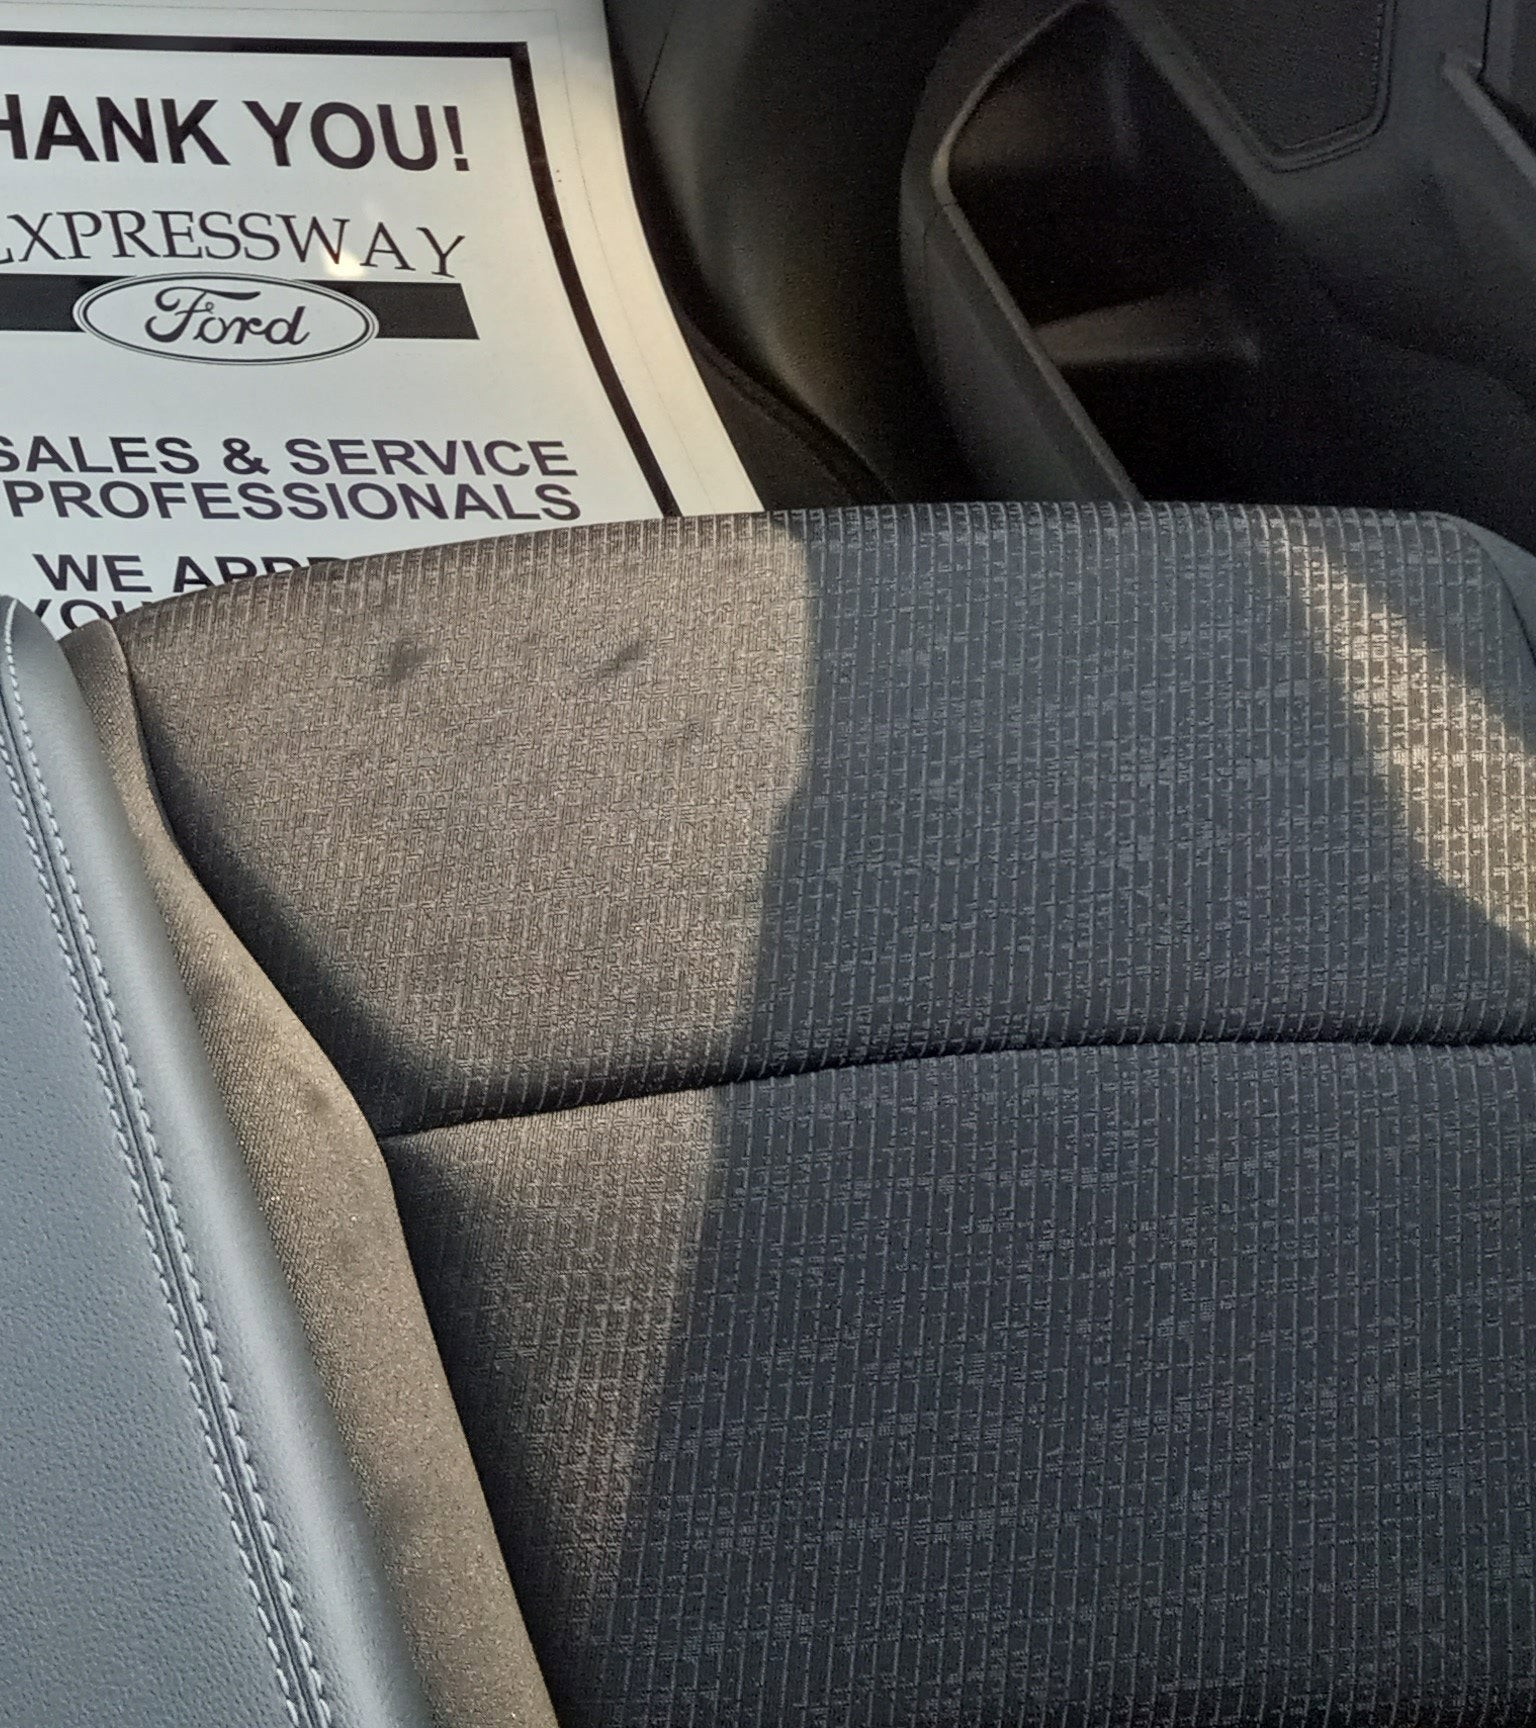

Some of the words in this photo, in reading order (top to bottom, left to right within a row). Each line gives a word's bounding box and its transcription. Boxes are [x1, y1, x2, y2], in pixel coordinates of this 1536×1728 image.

[243, 98, 471, 173] YOU!
[142, 284, 311, 348] Ford
[220, 435, 274, 475] &
[285, 437, 579, 478] SERVICE
[3, 480, 583, 522] PROFESSIONALS
[31, 552, 154, 593] WE
